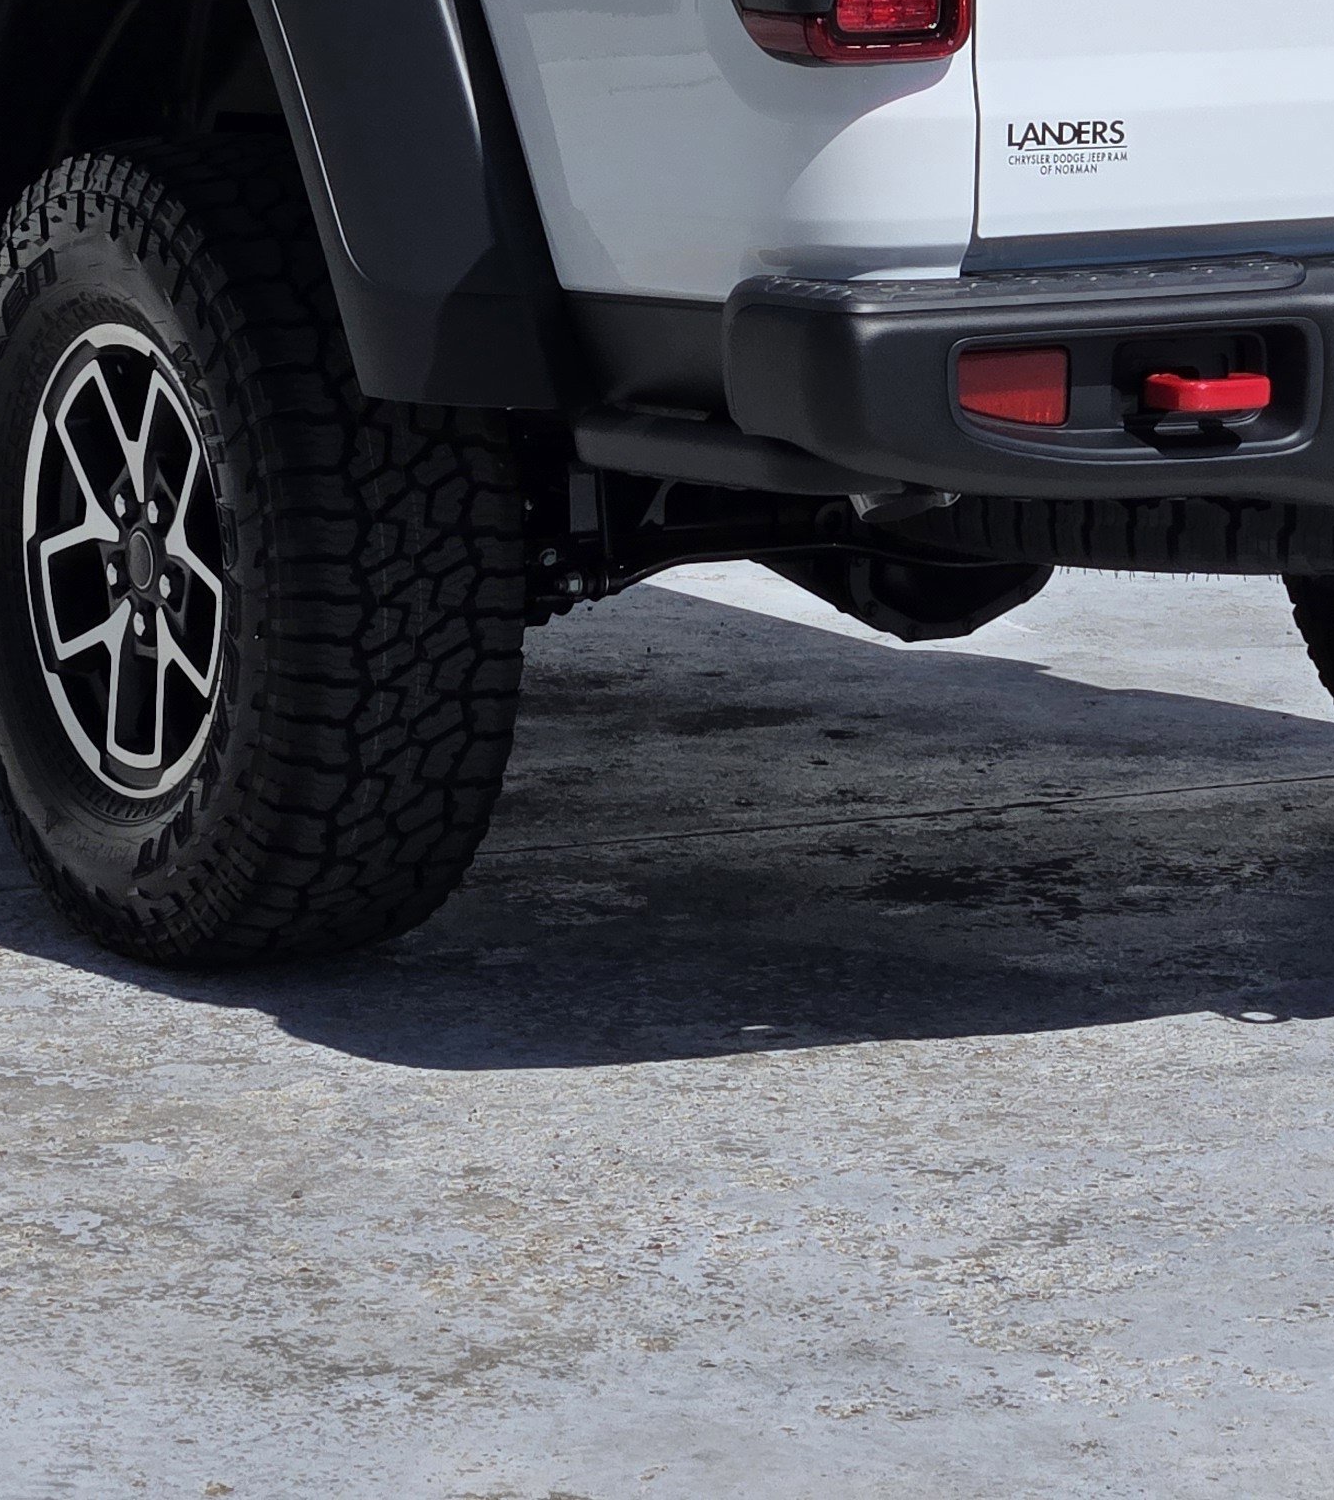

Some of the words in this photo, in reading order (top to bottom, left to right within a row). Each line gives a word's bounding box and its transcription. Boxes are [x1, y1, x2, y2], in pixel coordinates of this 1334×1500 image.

[1007, 120, 1125, 150] LANDERS
[1008, 154, 1050, 165] CHRYSLER
[1053, 153, 1084, 164] DODGE
[1087, 152, 1106, 163] JEEP
[1107, 152, 1128, 162] RAM
[1040, 165, 1052, 175] OF
[1055, 164, 1098, 174] NORMAN
